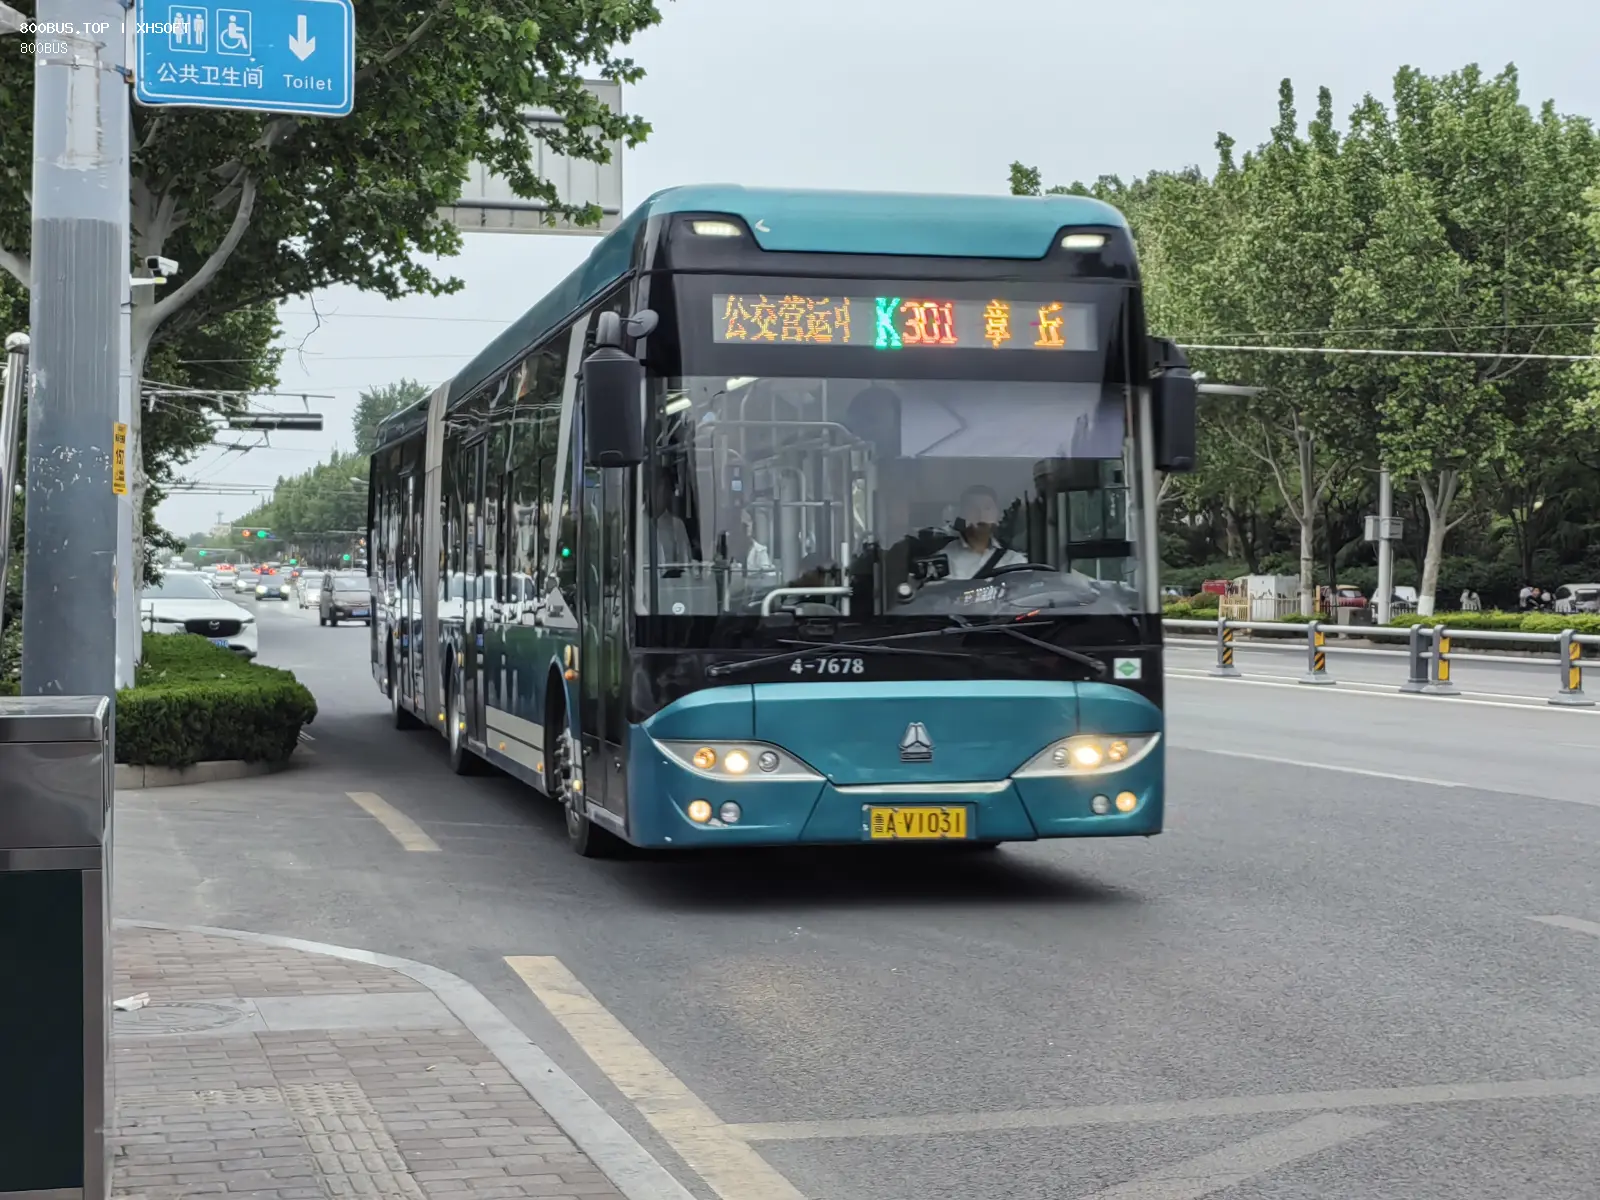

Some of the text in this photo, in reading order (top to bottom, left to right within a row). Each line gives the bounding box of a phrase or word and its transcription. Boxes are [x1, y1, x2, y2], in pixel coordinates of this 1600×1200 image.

[156, 61, 264, 89] 公共卫生间
[283, 74, 333, 91] Toilet
[875, 297, 958, 348] K301
[790, 658, 865, 674] 4-7678
